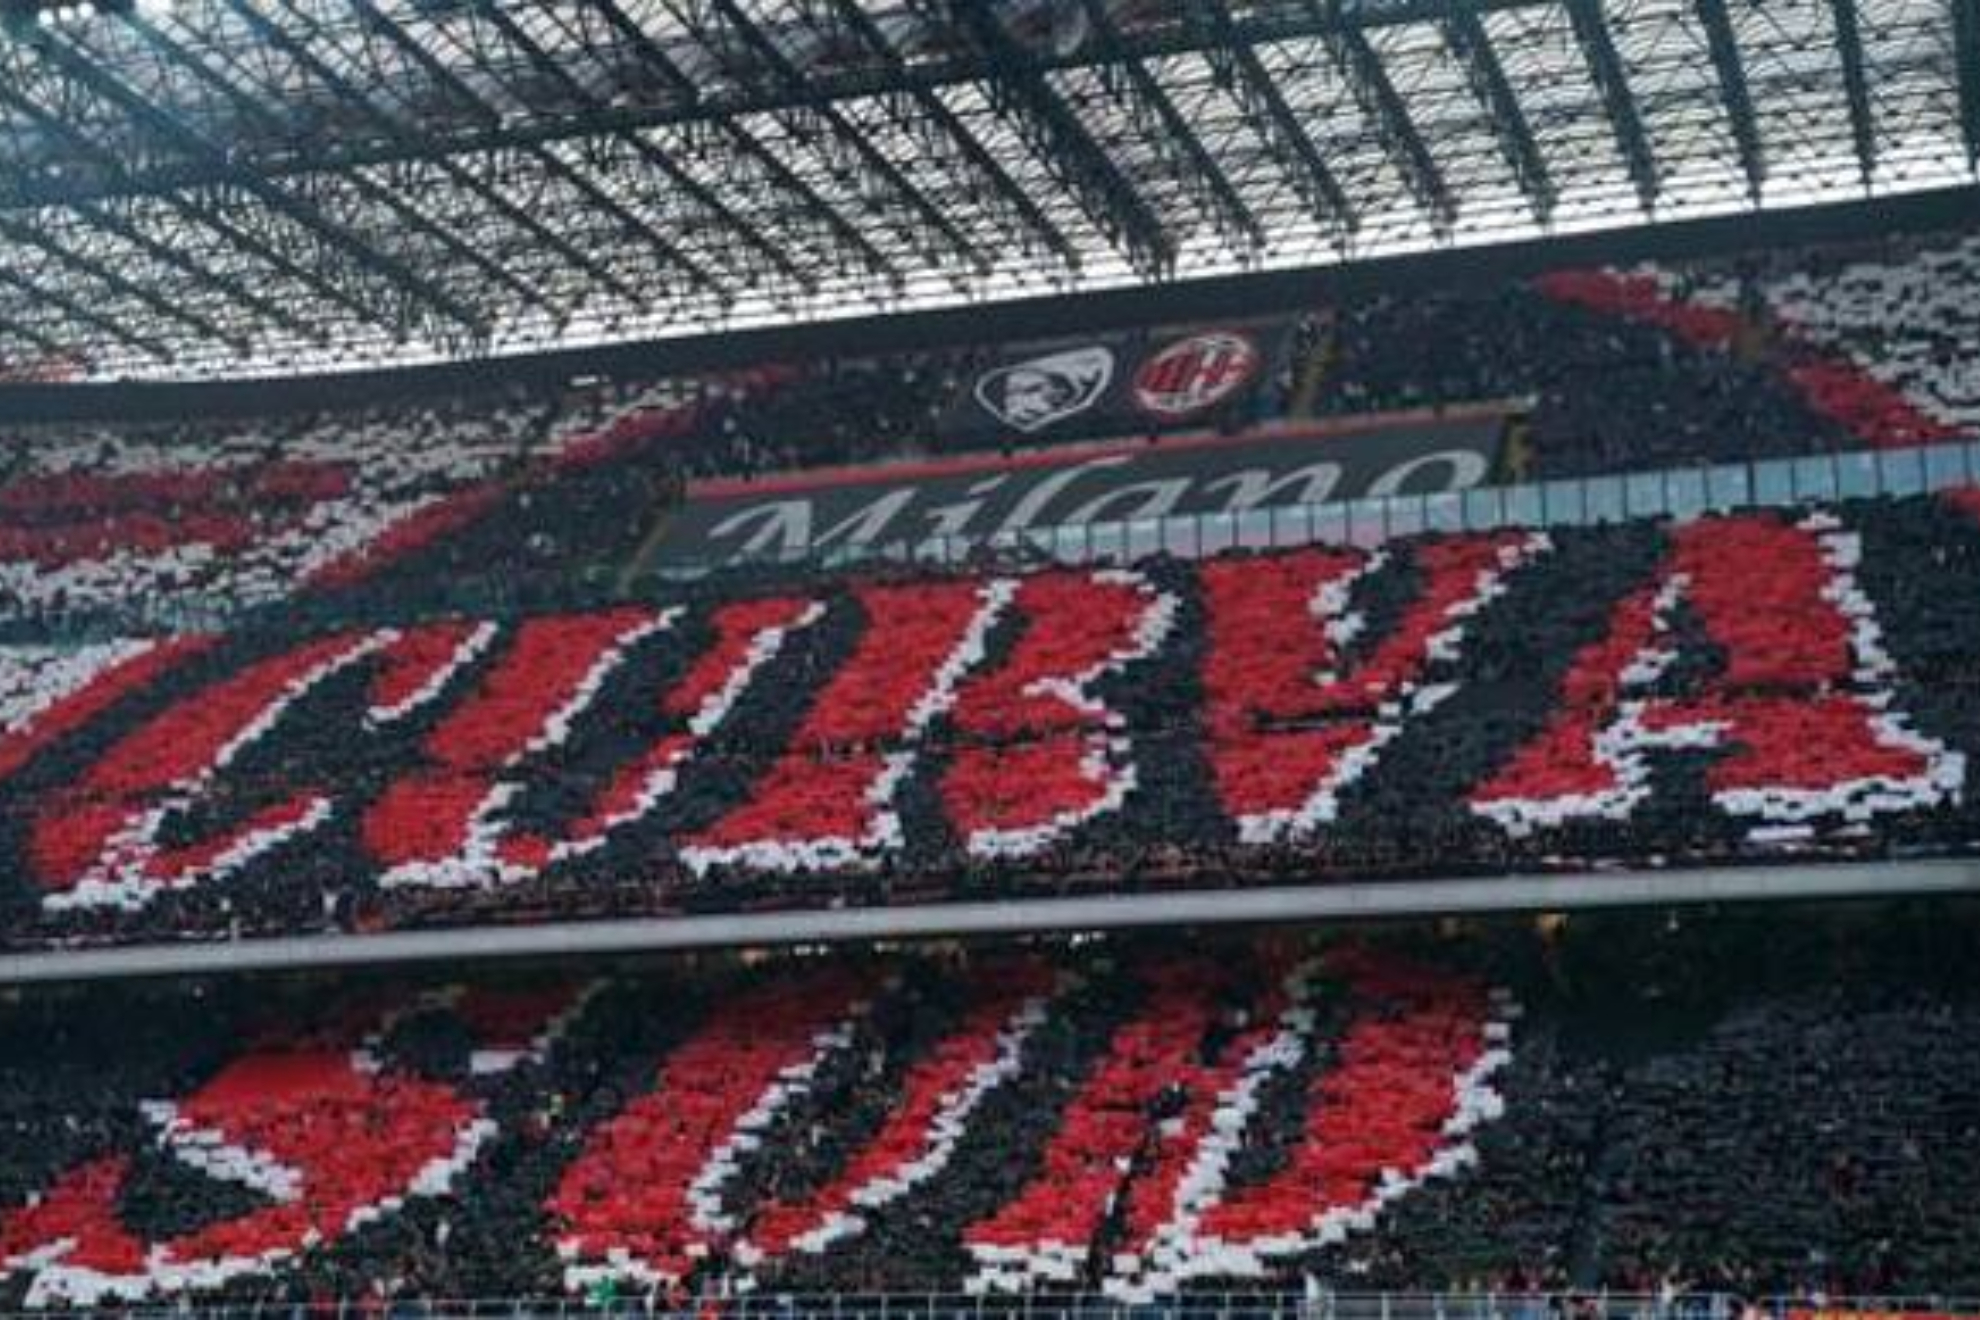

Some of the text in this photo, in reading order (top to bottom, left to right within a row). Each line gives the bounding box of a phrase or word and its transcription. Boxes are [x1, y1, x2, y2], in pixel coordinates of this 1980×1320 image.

[708, 449, 1488, 567] Milano
[24, 510, 1966, 910] CURVA
[0, 958, 1522, 1304] SUD
